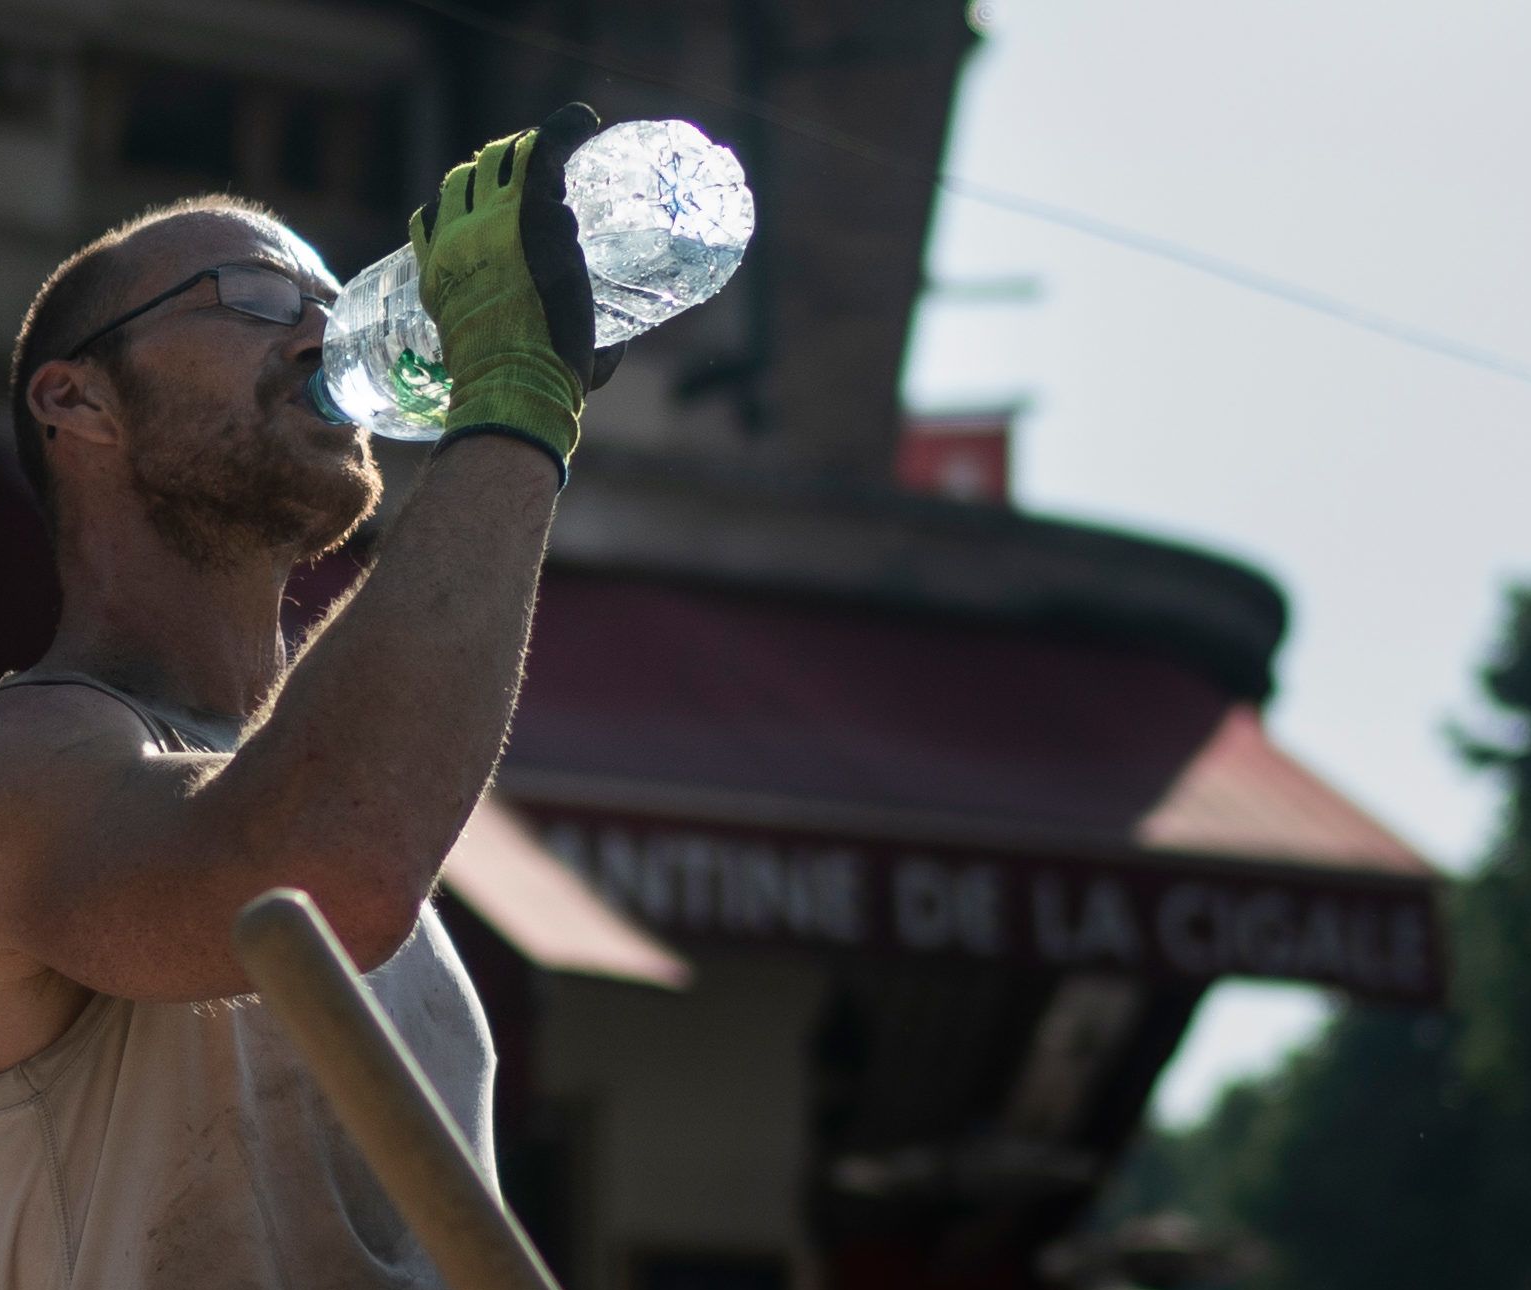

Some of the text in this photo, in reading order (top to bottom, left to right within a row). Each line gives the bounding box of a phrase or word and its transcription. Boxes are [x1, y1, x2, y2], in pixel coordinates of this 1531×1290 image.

[892, 854, 1004, 958] DE
[1031, 868, 1141, 967] LA
[1157, 879, 1430, 992] CIGALE
